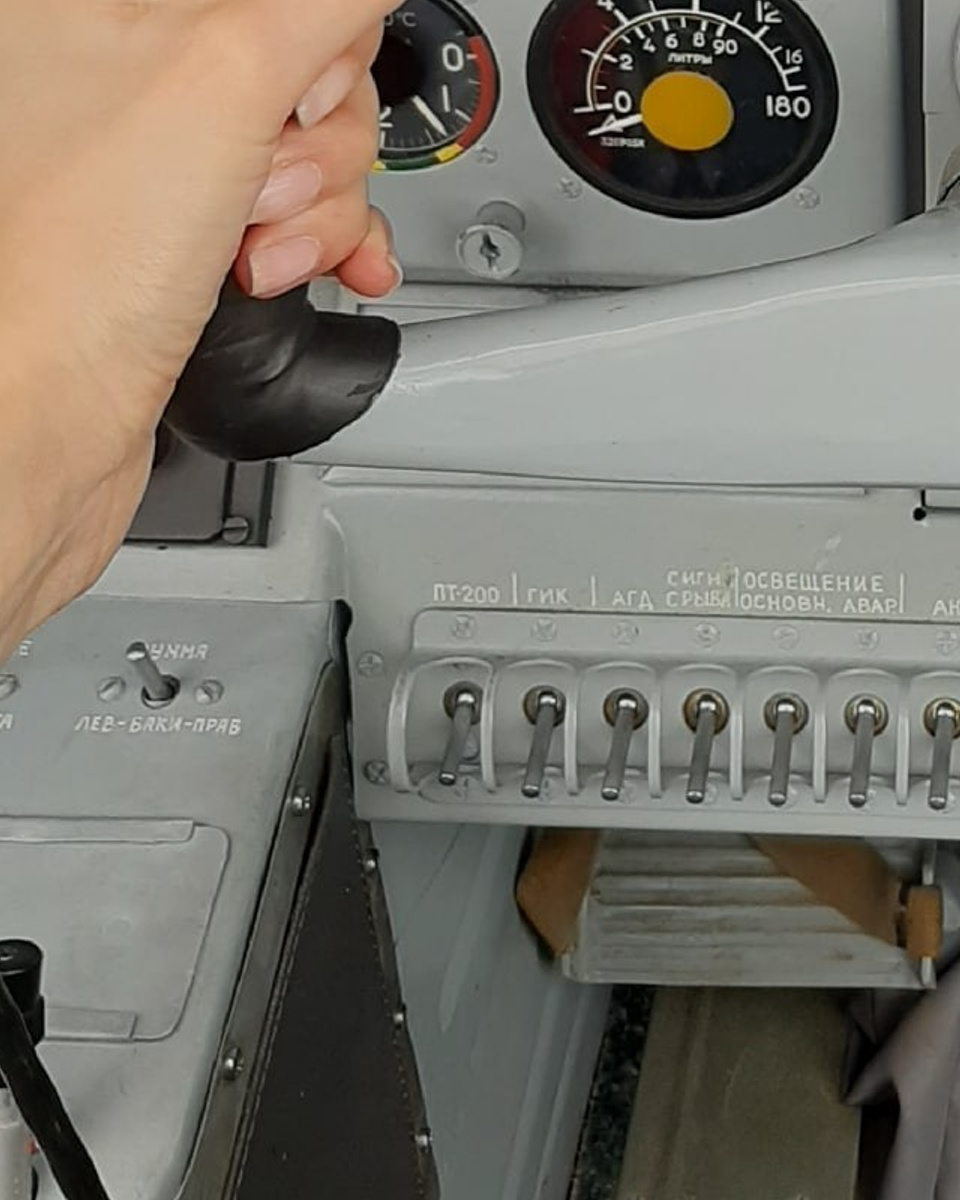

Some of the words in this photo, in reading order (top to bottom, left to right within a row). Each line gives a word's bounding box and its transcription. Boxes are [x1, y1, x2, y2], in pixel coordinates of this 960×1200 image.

[755, 0, 783, 24] 12
[642, 38, 656, 53] 4
[665, 33, 679, 49] 6
[692, 31, 705, 48] 8
[712, 39, 739, 55] 90
[442, 42, 465, 72] 0
[619, 53, 634, 71] 2
[785, 49, 804, 65] 16
[613, 90, 633, 114] 0
[765, 94, 812, 120] 180
[744, 571, 885, 593] ОСВЕЩЕНИЕ
[433, 583, 499, 604] ПТ-200
[527, 587, 568, 604] ГИК
[612, 590, 654, 611] АГД
[146, 642, 209, 661] УММА
